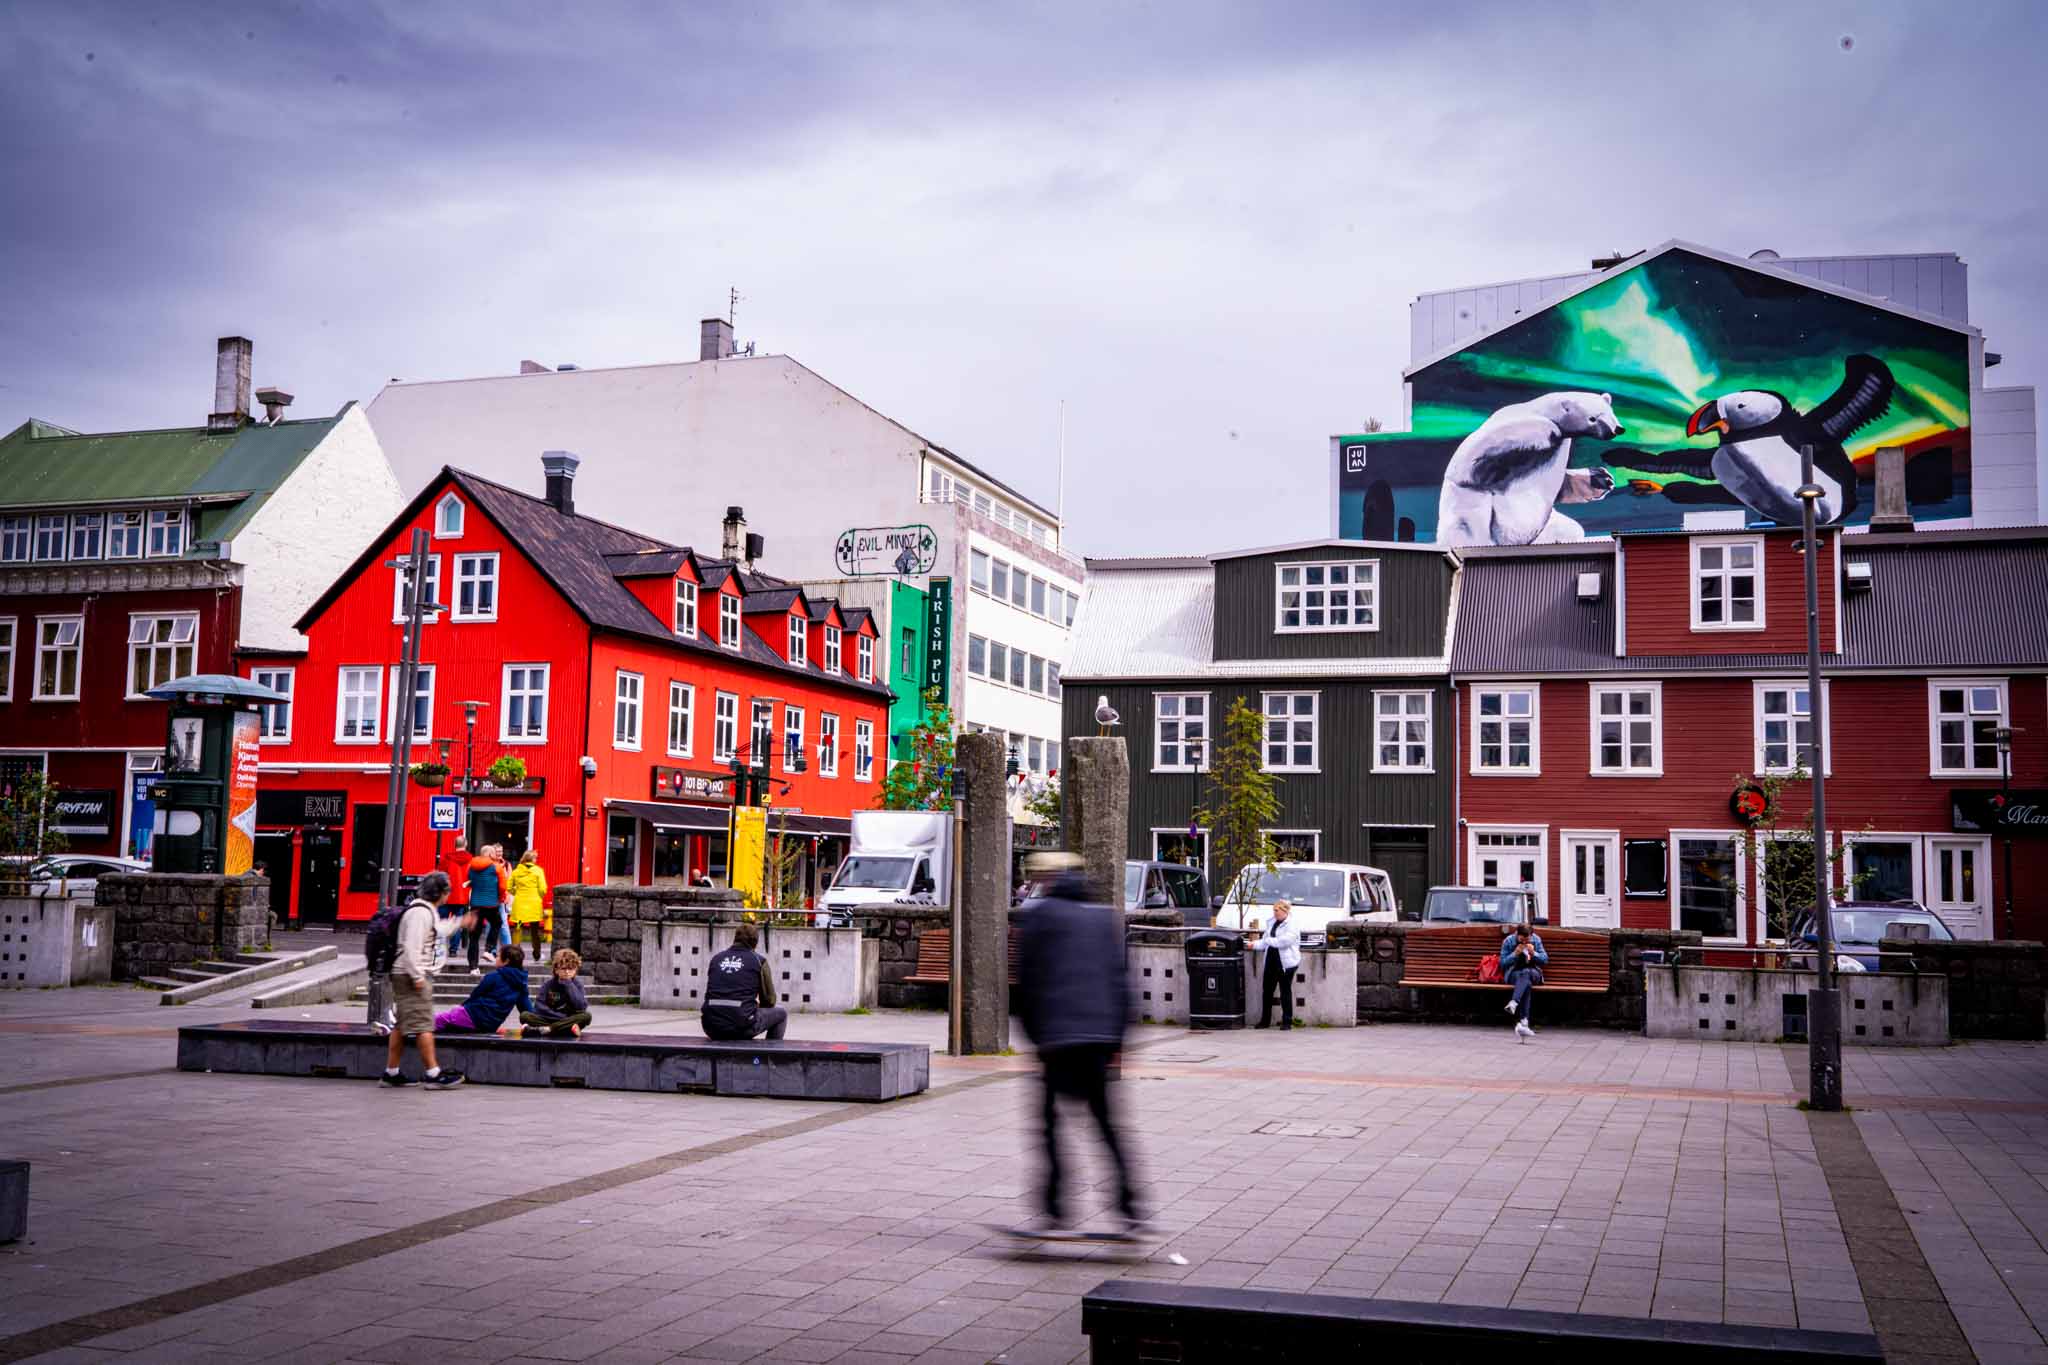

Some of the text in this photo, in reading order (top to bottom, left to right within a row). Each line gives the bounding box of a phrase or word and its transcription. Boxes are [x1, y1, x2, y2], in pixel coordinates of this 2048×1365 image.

[859, 537, 882, 551] EVIL
[932, 588, 943, 651] IRISH
[154, 789, 167, 798] WC
[305, 796, 342, 813] EXIT
[436, 808, 454, 817] WC
